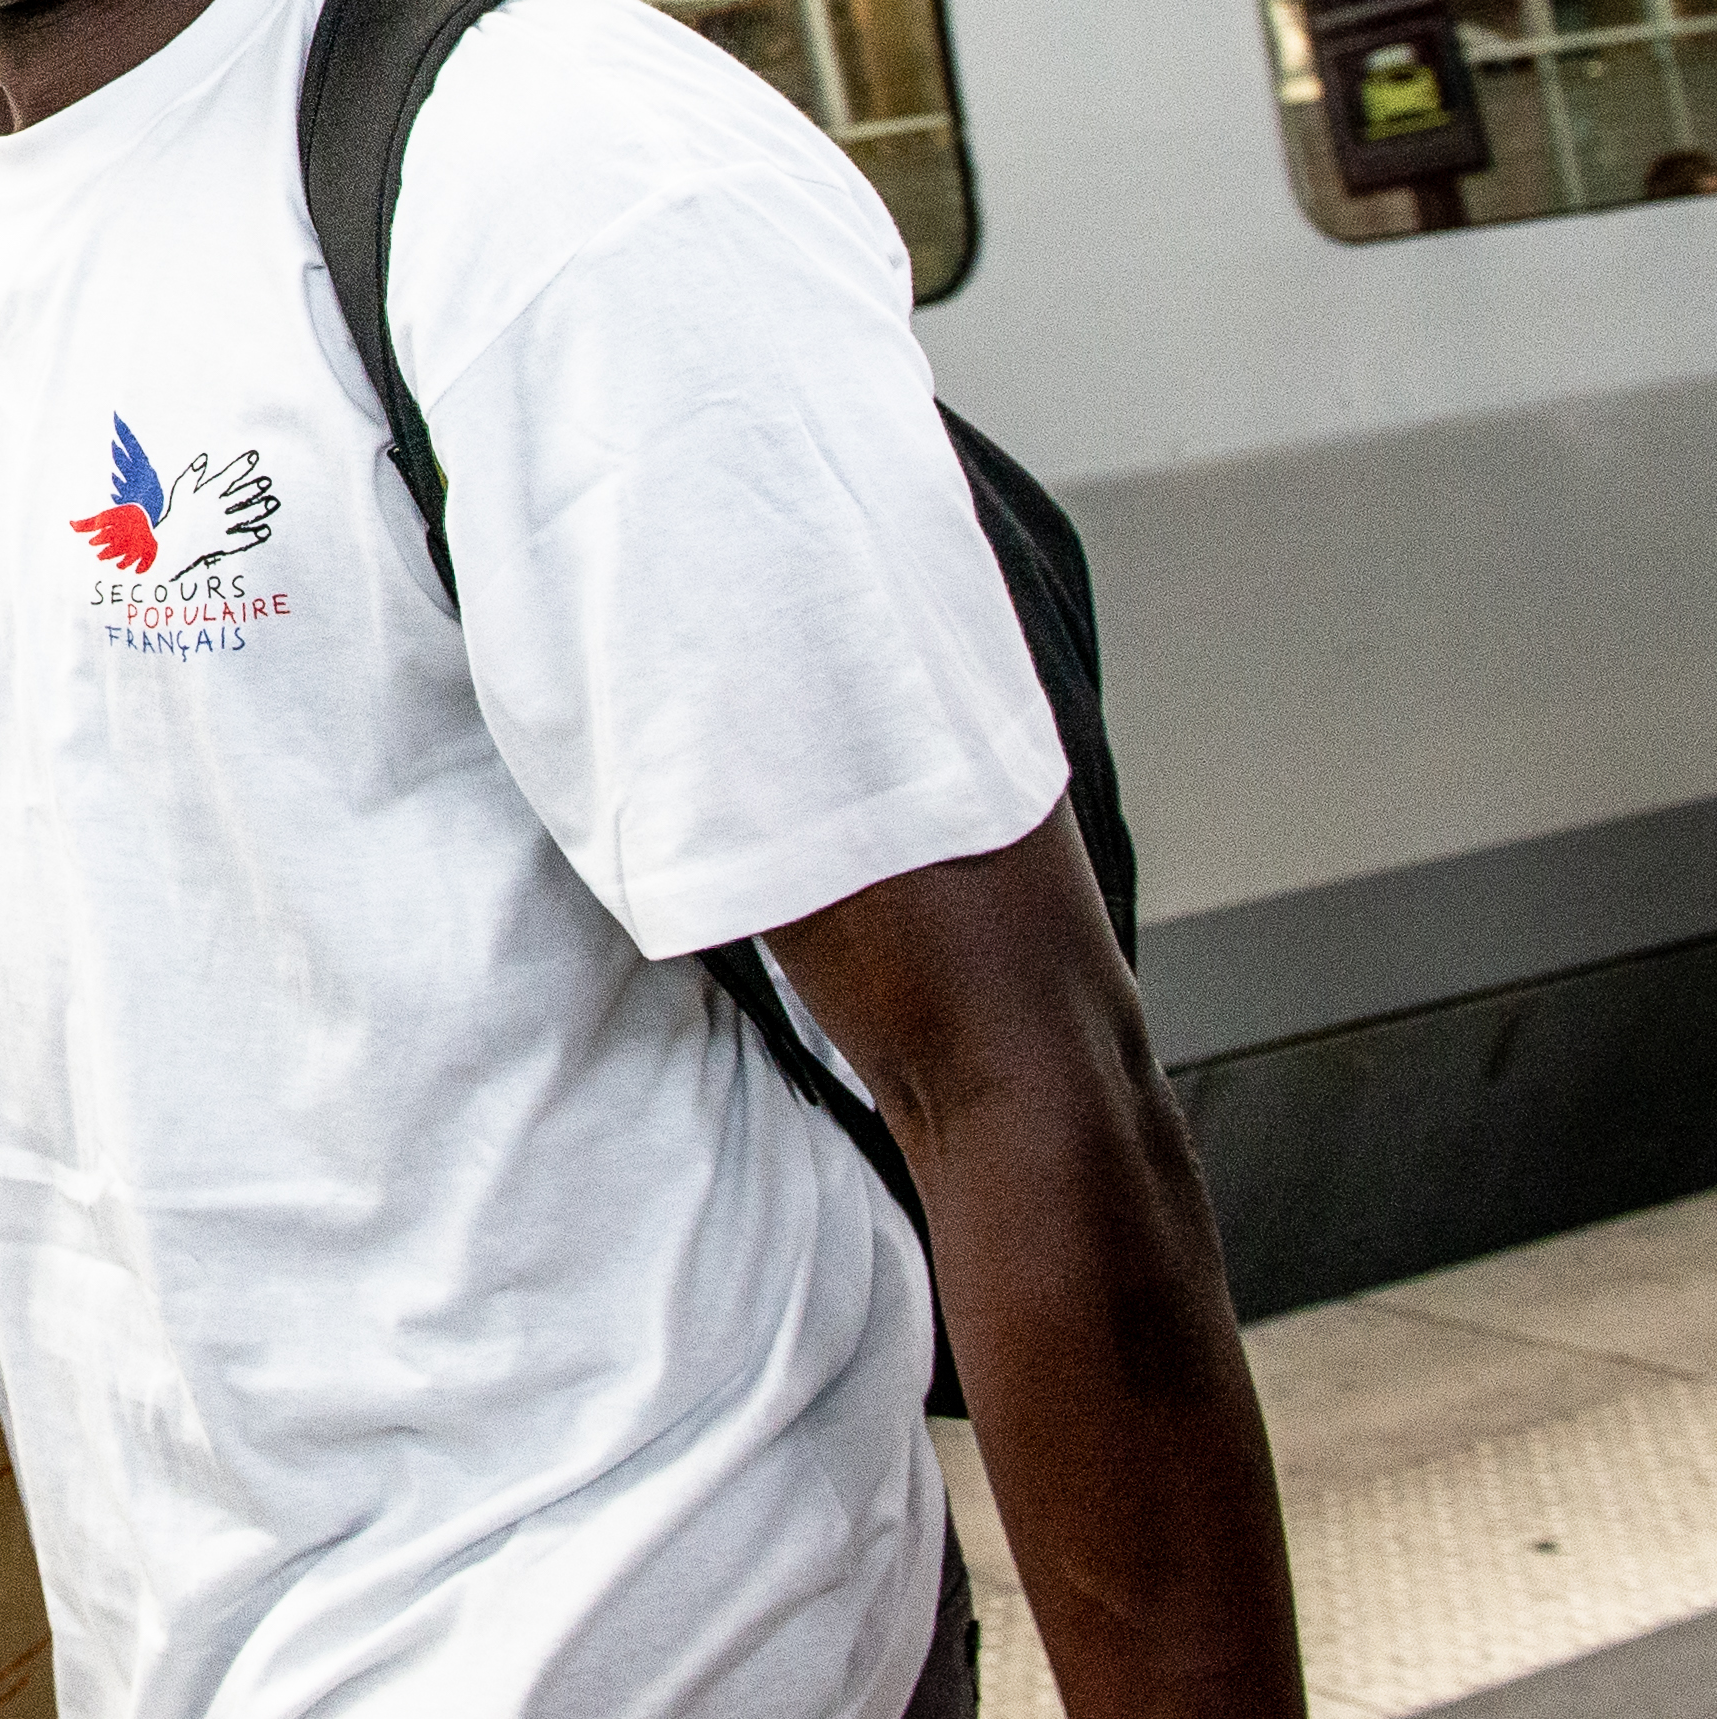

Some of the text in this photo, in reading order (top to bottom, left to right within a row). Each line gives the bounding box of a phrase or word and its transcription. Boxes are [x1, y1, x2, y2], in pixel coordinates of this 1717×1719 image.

[91, 574, 246, 605] SECOURS
[127, 593, 291, 628] POPULAIRE
[105, 626, 246, 662] FRANÇAIS
